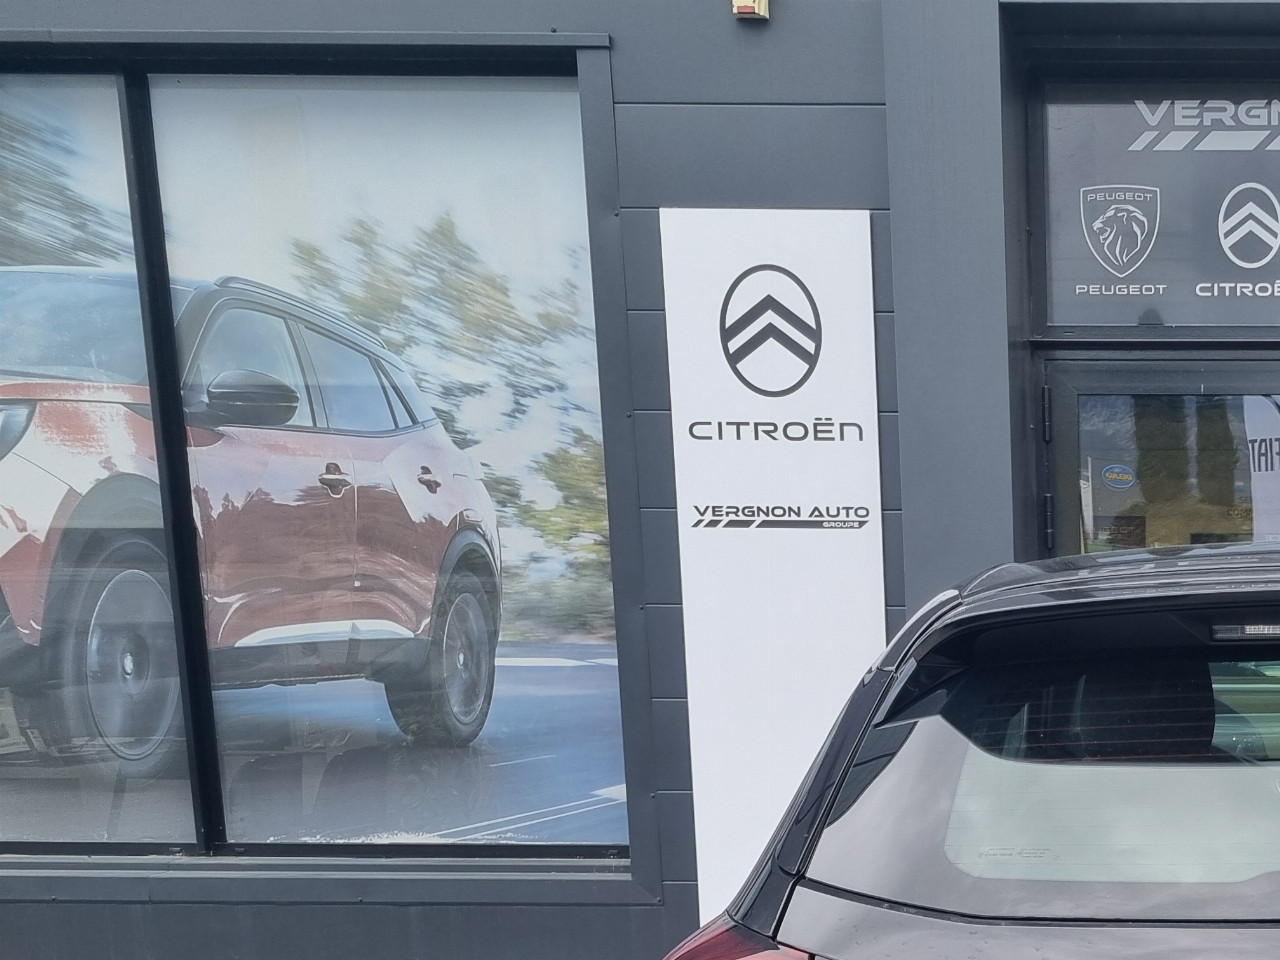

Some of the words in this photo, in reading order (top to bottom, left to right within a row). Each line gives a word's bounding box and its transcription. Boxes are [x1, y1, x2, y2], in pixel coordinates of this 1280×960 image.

[1087, 191, 1153, 202] PEUGEOT
[1075, 284, 1167, 295] PEUGEOT
[688, 417, 864, 442] CITROËN
[693, 505, 802, 518] VERGNON
[808, 505, 870, 519] AUTO
